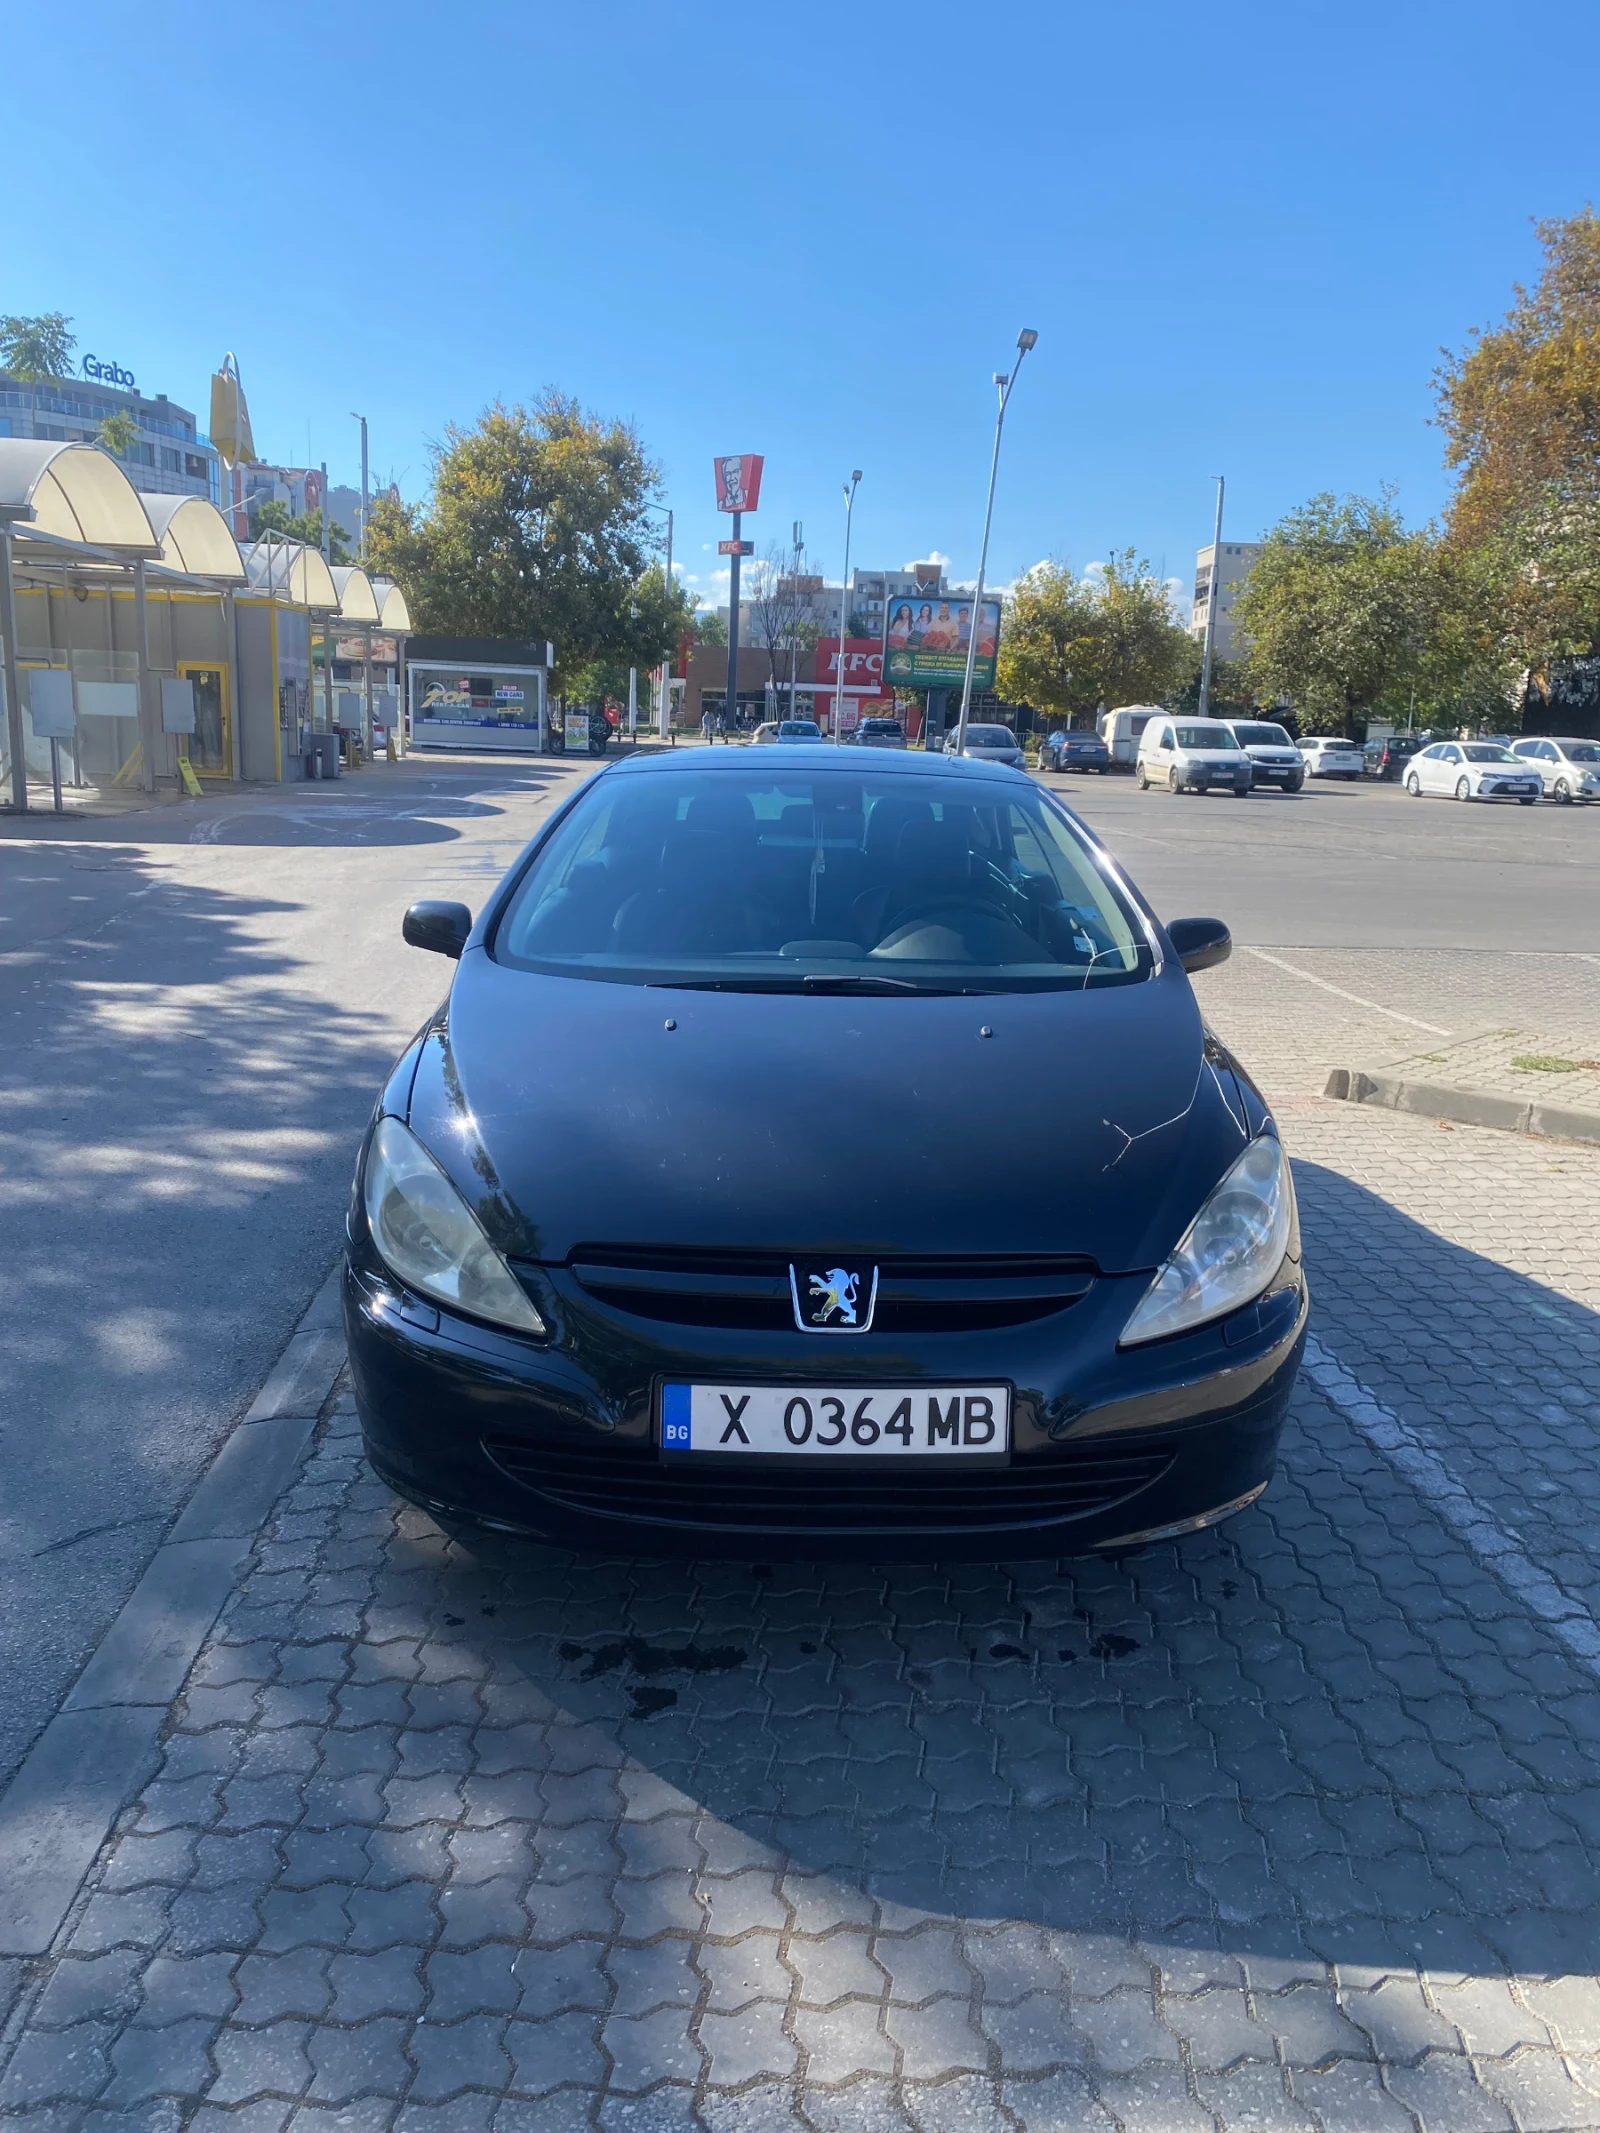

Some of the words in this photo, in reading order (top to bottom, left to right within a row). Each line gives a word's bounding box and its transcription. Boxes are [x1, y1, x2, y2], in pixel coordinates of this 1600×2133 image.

[82, 353, 135, 387] Grabo
[720, 541, 739, 552] KFC
[827, 652, 884, 672] KFC
[420, 690, 471, 708] TOP
[719, 1394, 751, 1444] X
[783, 1396, 914, 1446] 0364
[927, 1396, 996, 1446] MB
[666, 1424, 689, 1440] BG
